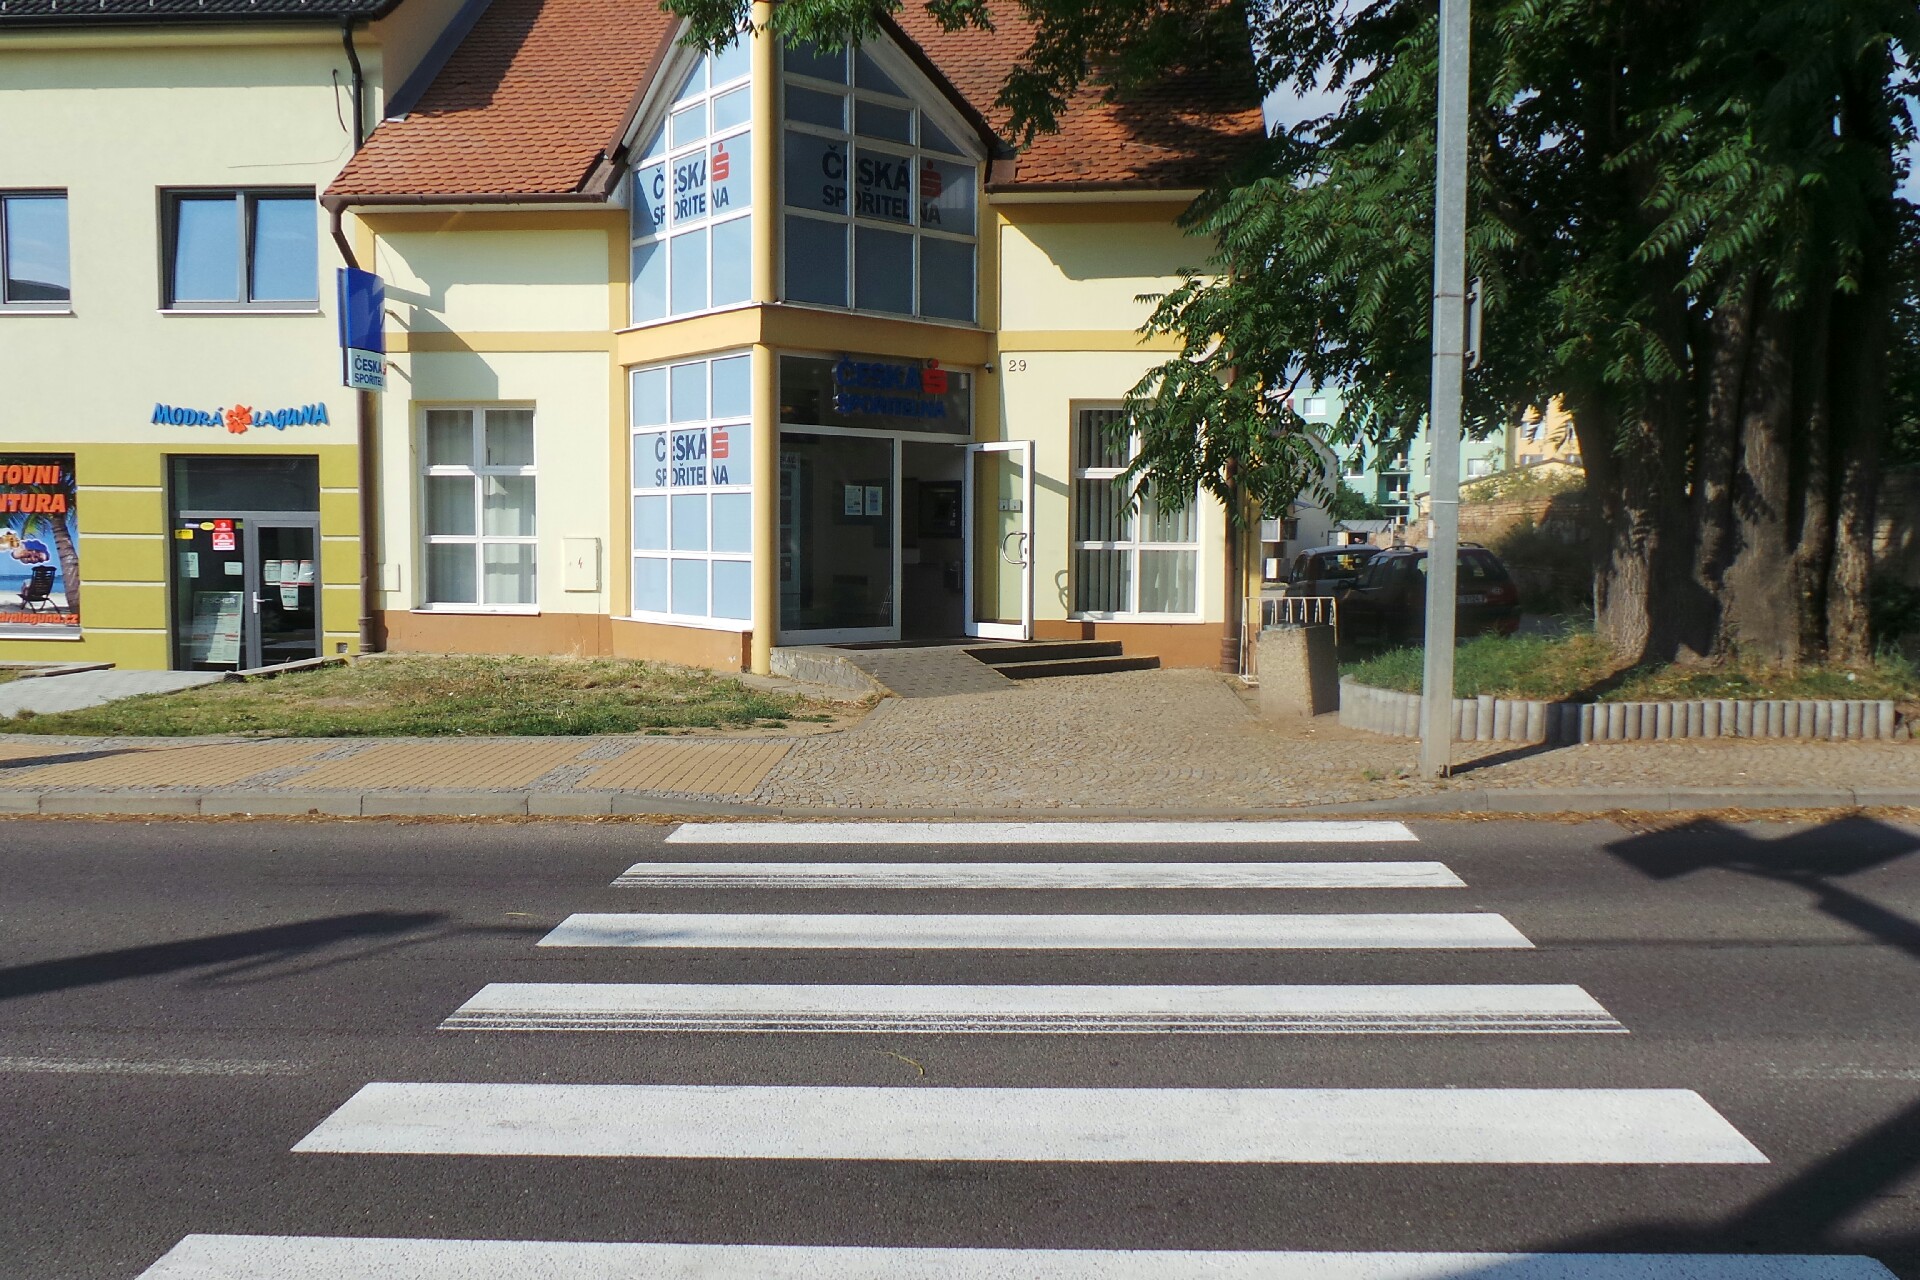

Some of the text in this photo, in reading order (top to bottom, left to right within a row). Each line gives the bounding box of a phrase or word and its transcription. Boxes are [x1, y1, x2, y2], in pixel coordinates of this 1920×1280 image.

[653, 186, 729, 226] SPOŘITENA
[1008, 359, 1027, 372] 29
[150, 401, 330, 431] MODRÁ LAGUNA
